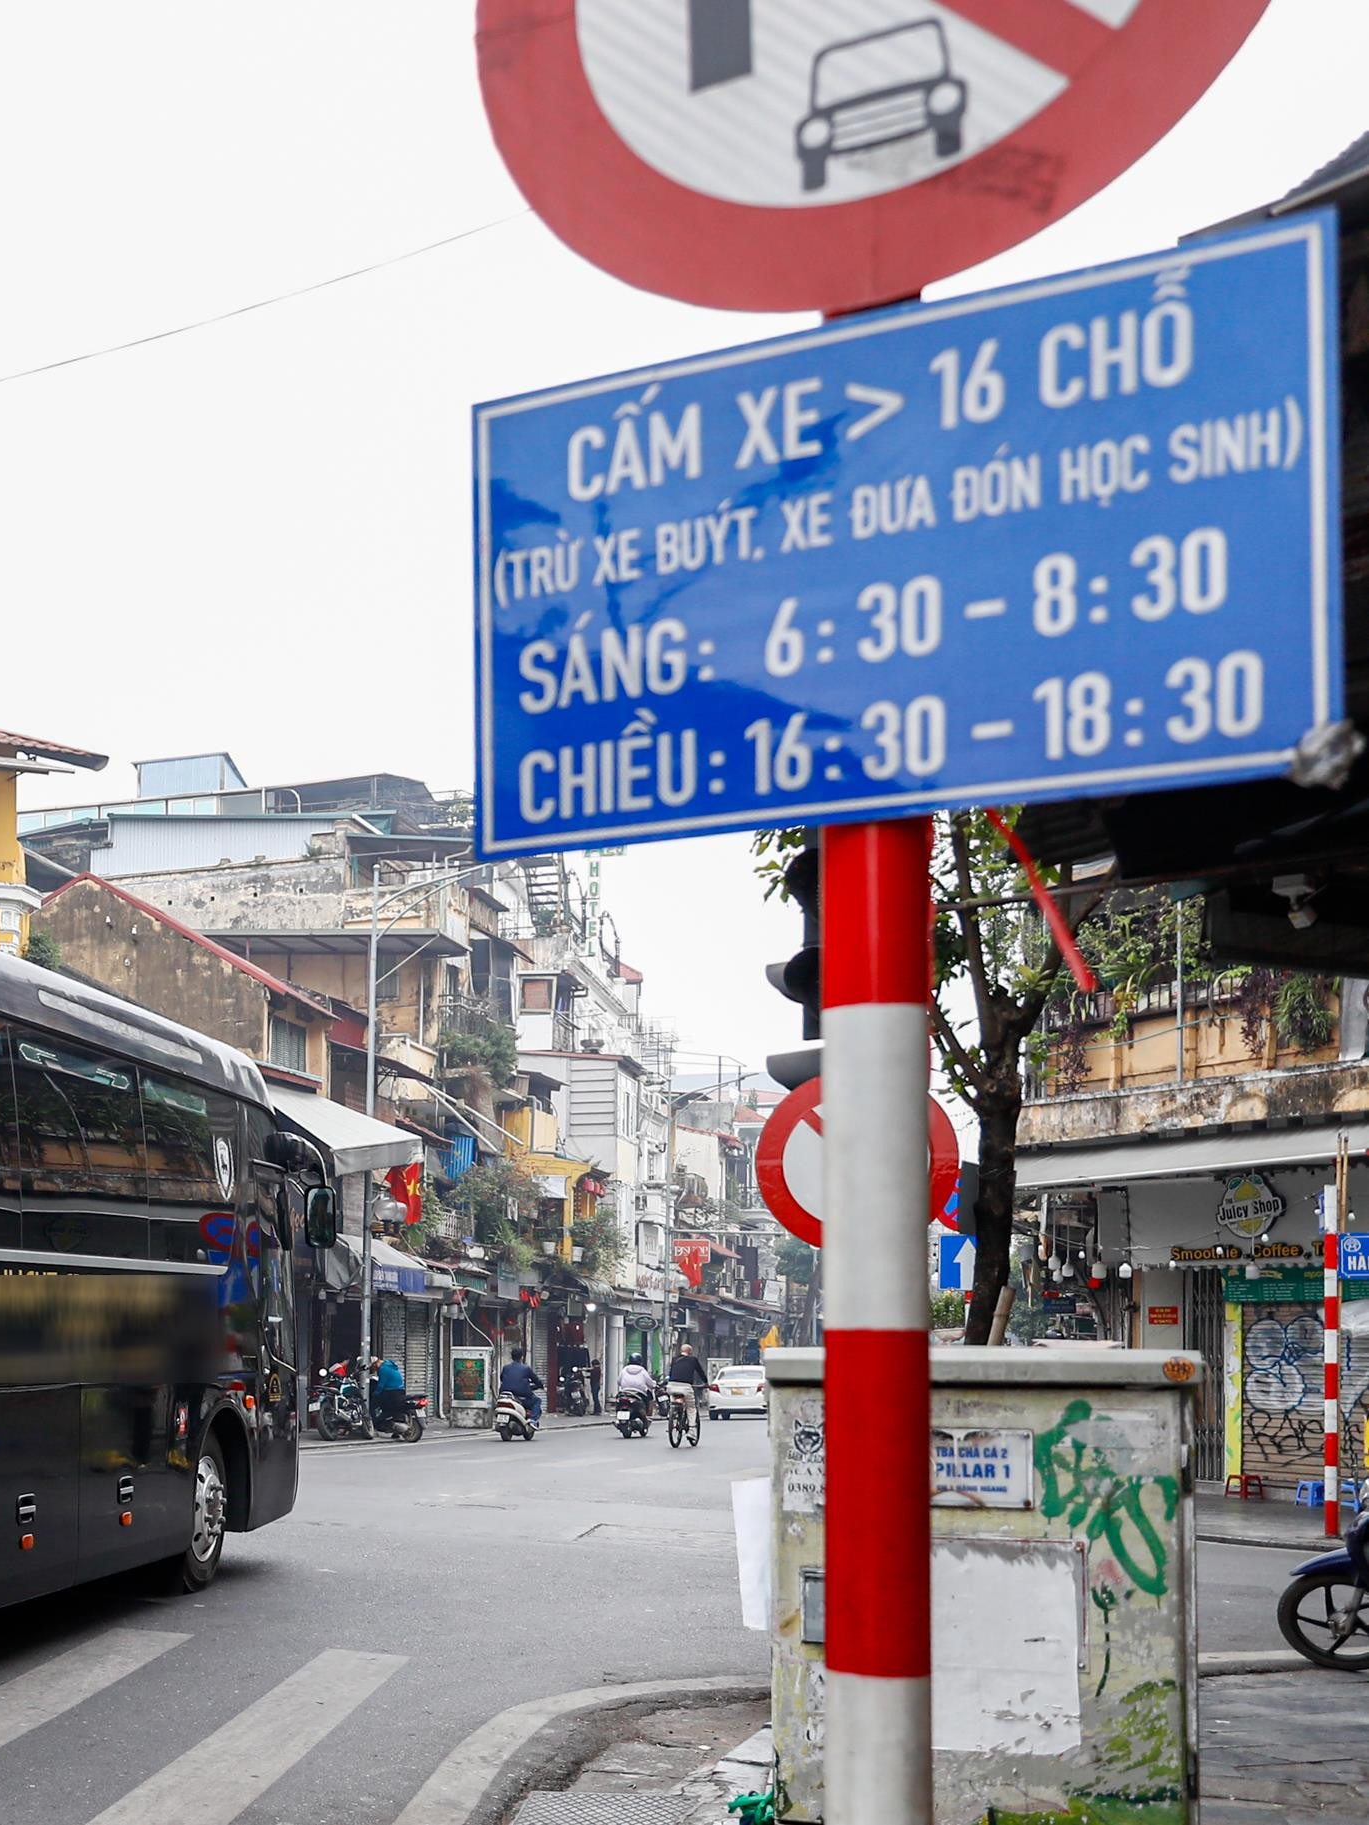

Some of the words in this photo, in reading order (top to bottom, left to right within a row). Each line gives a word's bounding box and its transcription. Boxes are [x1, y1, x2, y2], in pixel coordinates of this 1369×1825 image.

[567, 382, 702, 502] CẤM
[734, 377, 823, 470] XE
[929, 339, 1005, 430] 16
[1039, 264, 1194, 409] CHỖ
[494, 528, 584, 609] (TRỪ
[593, 527, 642, 587] XE
[780, 492, 834, 553] XE
[850, 475, 937, 540] ĐƯA
[951, 444, 1042, 523] ĐÓN
[1059, 434, 1150, 508] HỌC
[1169, 396, 1304, 484] SINH)
[520, 611, 716, 714] SÁNG:
[520, 708, 724, 823] CHIỀU:
[588, 861, 600, 957] HOTEL
[1219, 1205, 1248, 1221] Juicy
[1253, 1198, 1280, 1215] Shop
[1253, 1243, 1300, 1259] Coffee
[1001, 1448, 1008, 1459] 2
[1002, 1464, 1010, 1479] 1
